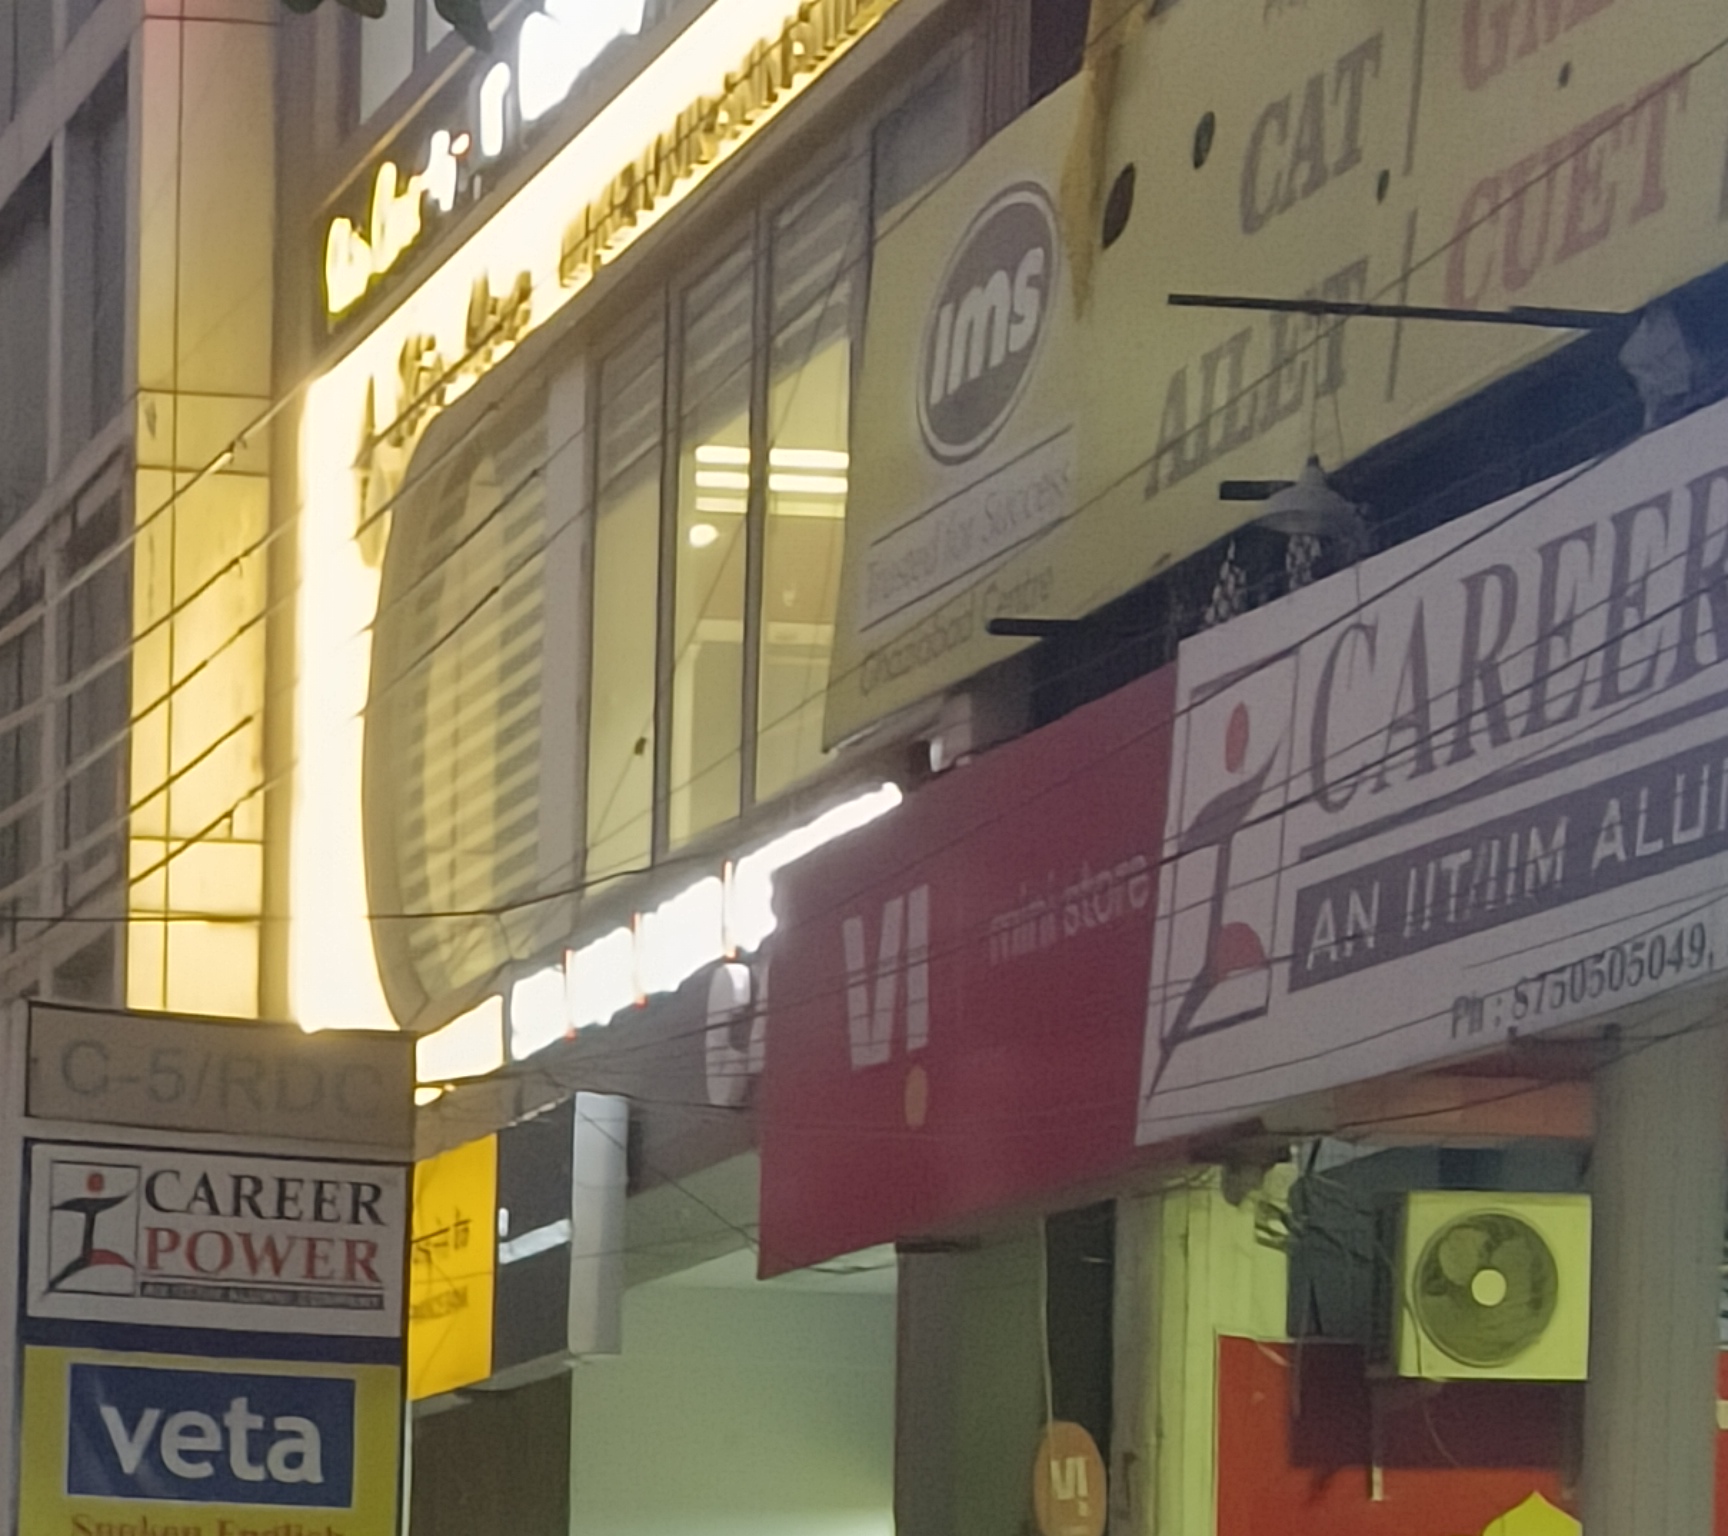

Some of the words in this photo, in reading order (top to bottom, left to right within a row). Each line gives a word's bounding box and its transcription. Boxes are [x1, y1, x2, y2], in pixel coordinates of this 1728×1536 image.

[1239, 32, 1383, 236] CAT
[1444, 64, 1690, 310] CUET
[1144, 256, 1370, 500] AILET
[1063, 853, 1150, 938] store
[1306, 880, 1380, 972] AN
[1590, 757, 1728, 876] ALU
[144, 1168, 387, 1226] CAREER
[144, 1226, 383, 1283] POWER
[98, 1396, 325, 1485] veta
